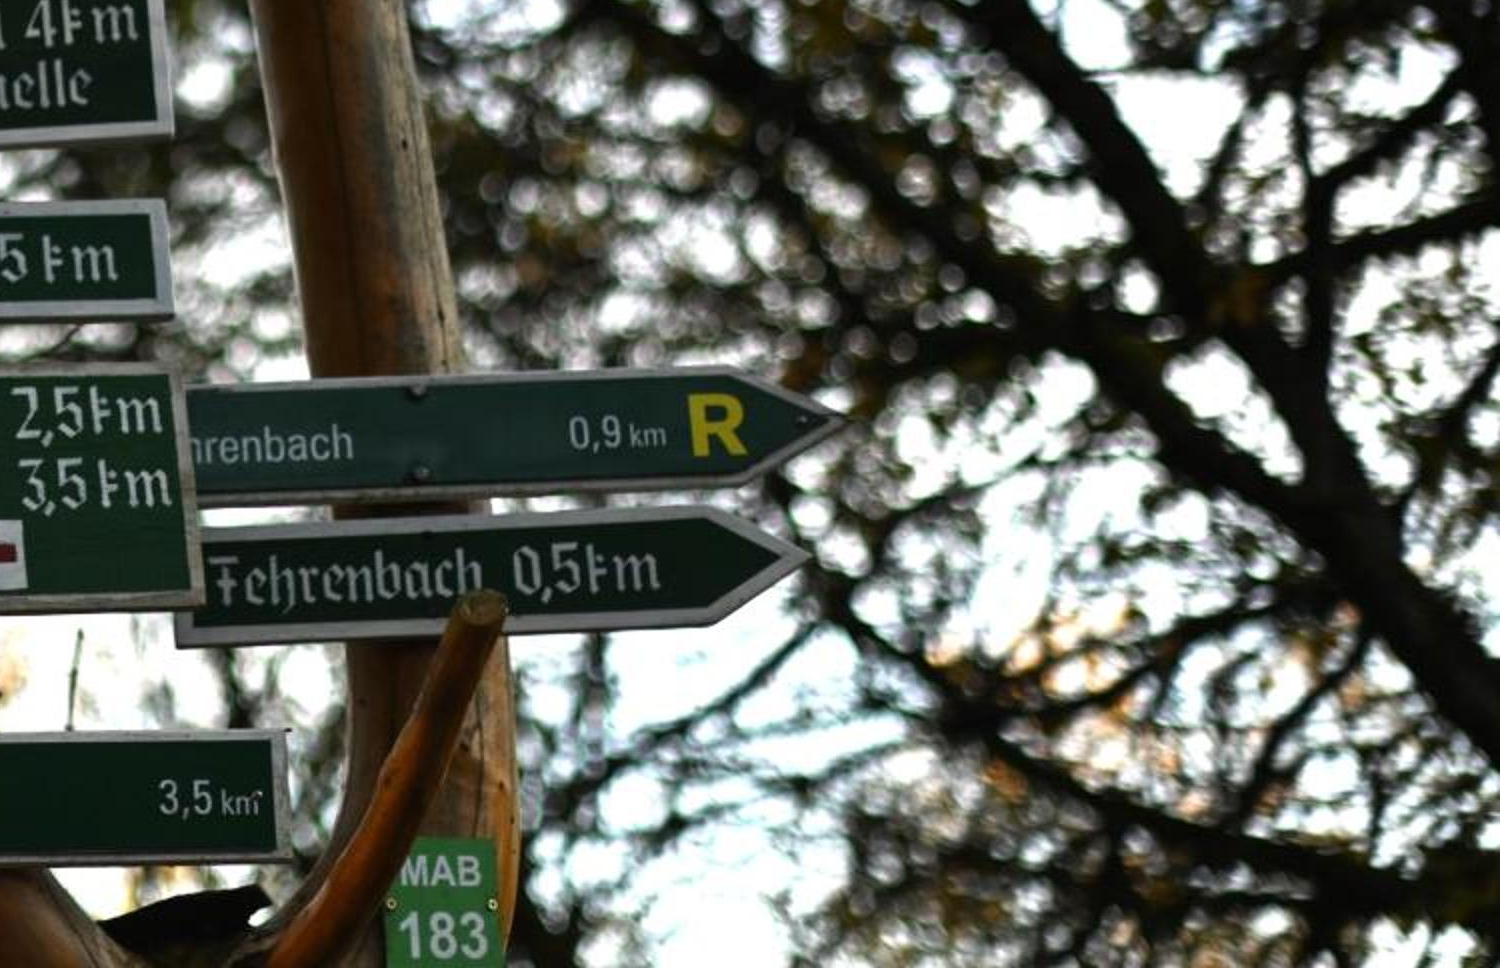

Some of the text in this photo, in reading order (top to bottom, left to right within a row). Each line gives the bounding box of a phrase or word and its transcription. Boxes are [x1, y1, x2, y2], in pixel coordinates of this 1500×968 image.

[569, 414, 622, 453] 0,9
[629, 423, 667, 448] km
[687, 393, 748, 457] R
[208, 547, 484, 614] Fehrenbach
[158, 778, 213, 820] 3,5
[221, 789, 259, 815] km
[401, 855, 482, 887] MAB
[400, 910, 488, 959] 183
